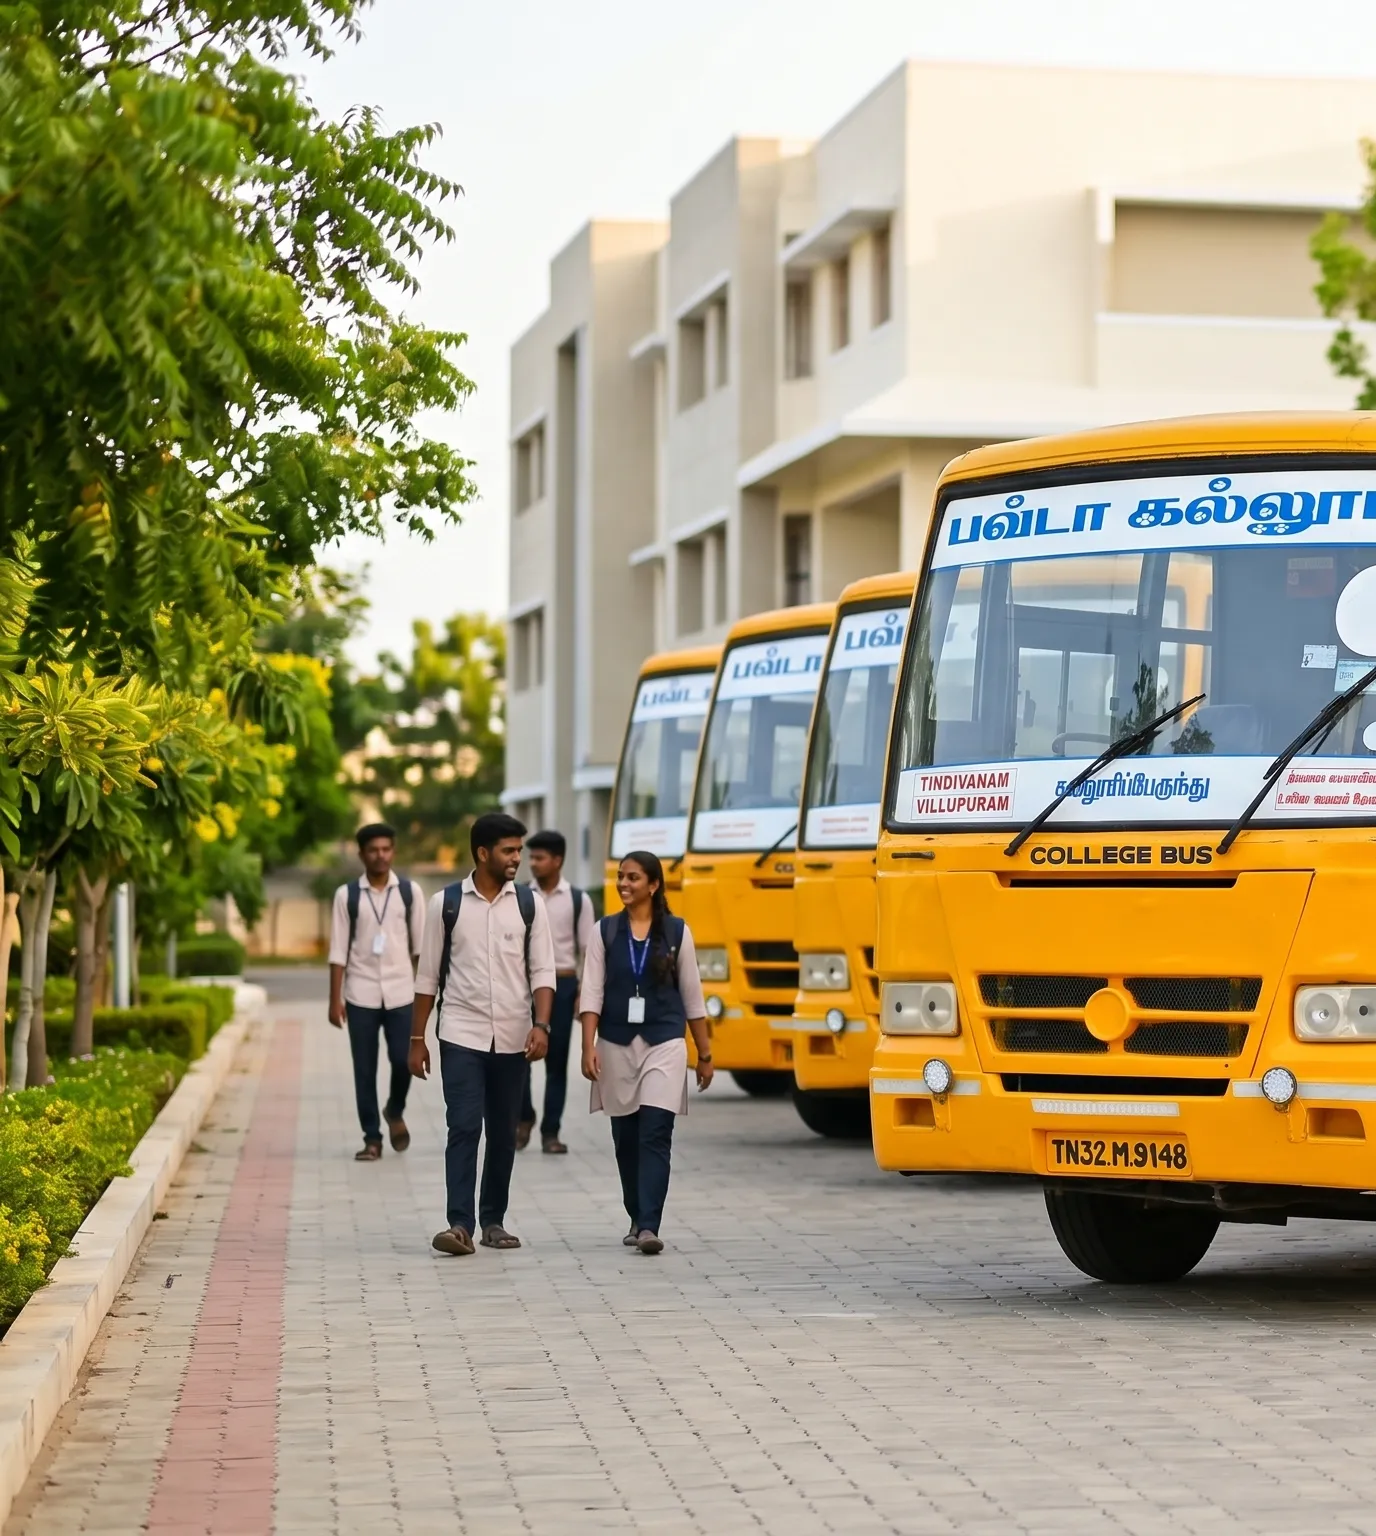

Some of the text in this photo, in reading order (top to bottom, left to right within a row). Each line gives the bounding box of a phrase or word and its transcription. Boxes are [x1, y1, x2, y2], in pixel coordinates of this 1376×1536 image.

[948, 494, 1112, 546] பவ்டா
[921, 772, 1010, 791] TINDIVANAM
[917, 796, 1009, 814] VILLUPURAM
[1030, 846, 1213, 865] COLLEGE BUS
[1051, 1139, 1188, 1170] TN32.M.9148
